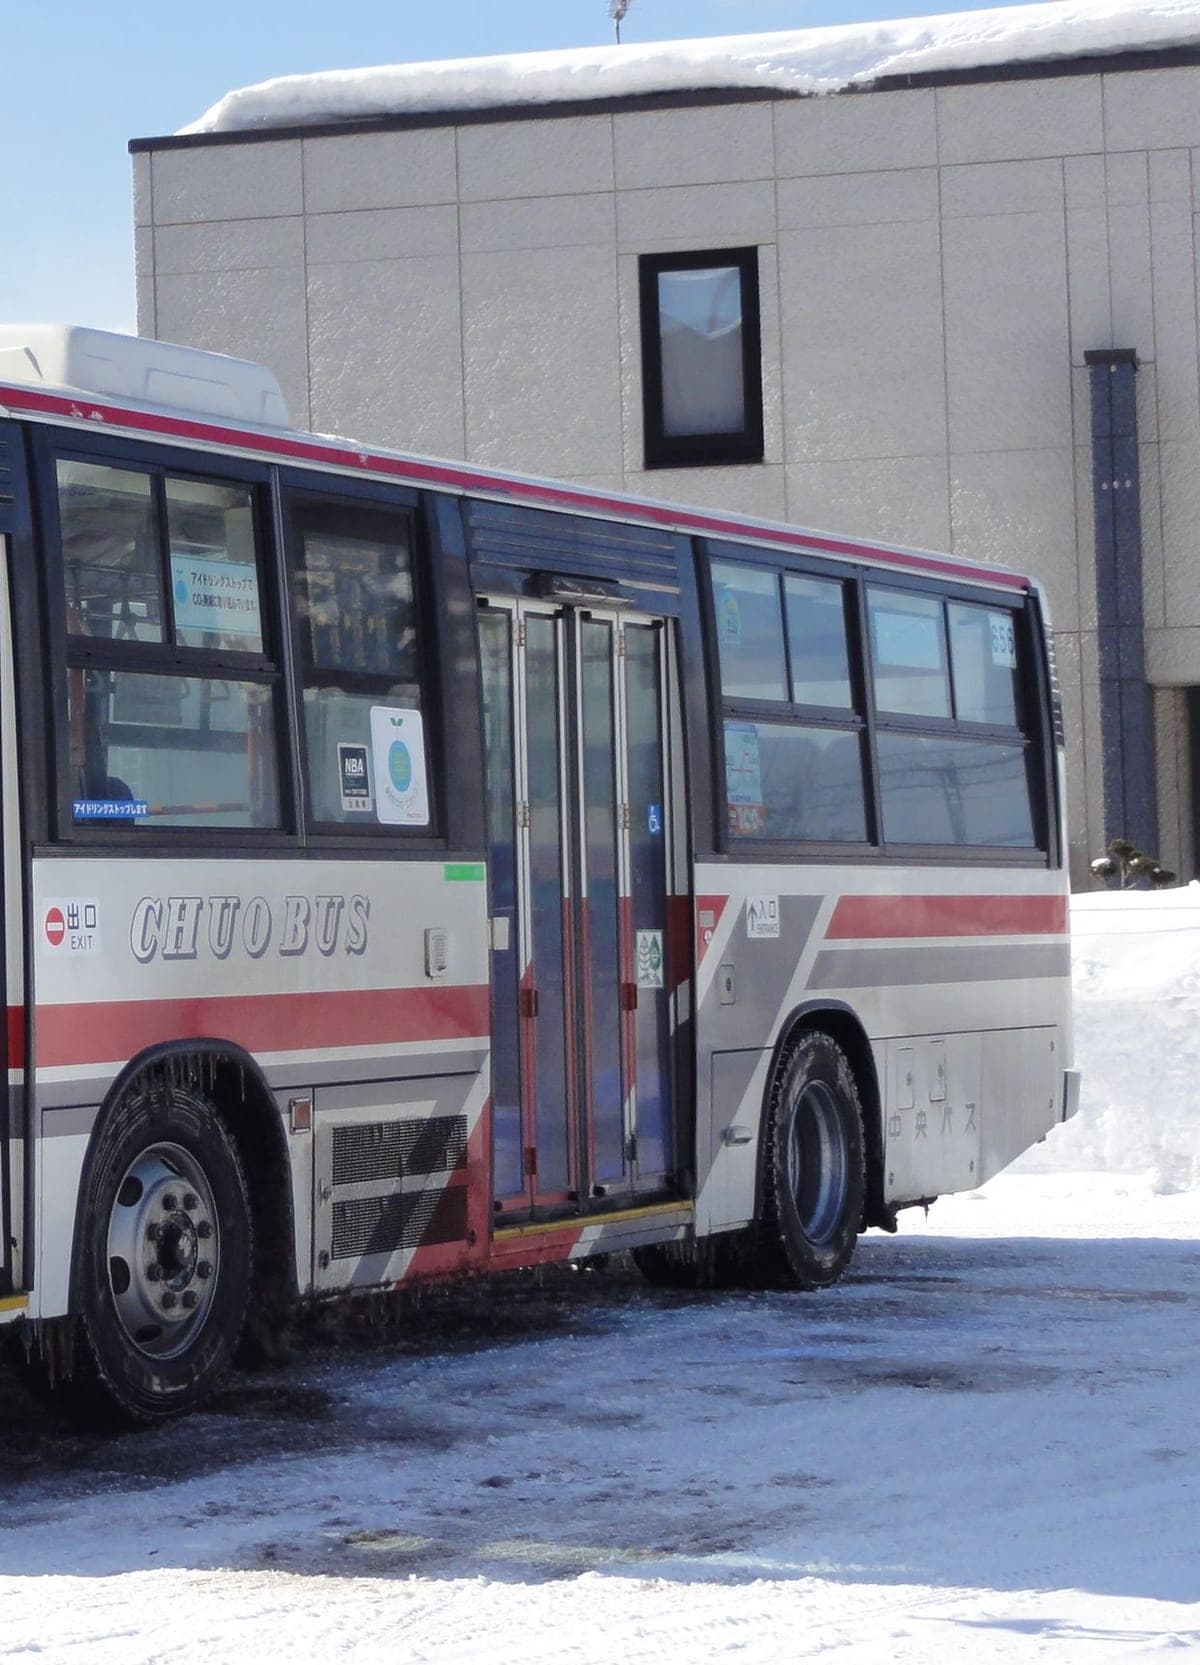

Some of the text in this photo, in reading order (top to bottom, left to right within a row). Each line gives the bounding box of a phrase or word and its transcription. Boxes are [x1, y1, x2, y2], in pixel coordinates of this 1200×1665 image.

[344, 758, 364, 773] NBA
[73, 803, 147, 815] アイドリングストップします
[67, 903, 97, 930] 出口
[759, 900, 777, 920] 入口
[130, 894, 371, 964] CHUO BUS
[71, 935, 93, 950] EXIT
[888, 1102, 977, 1142] 中央バス
